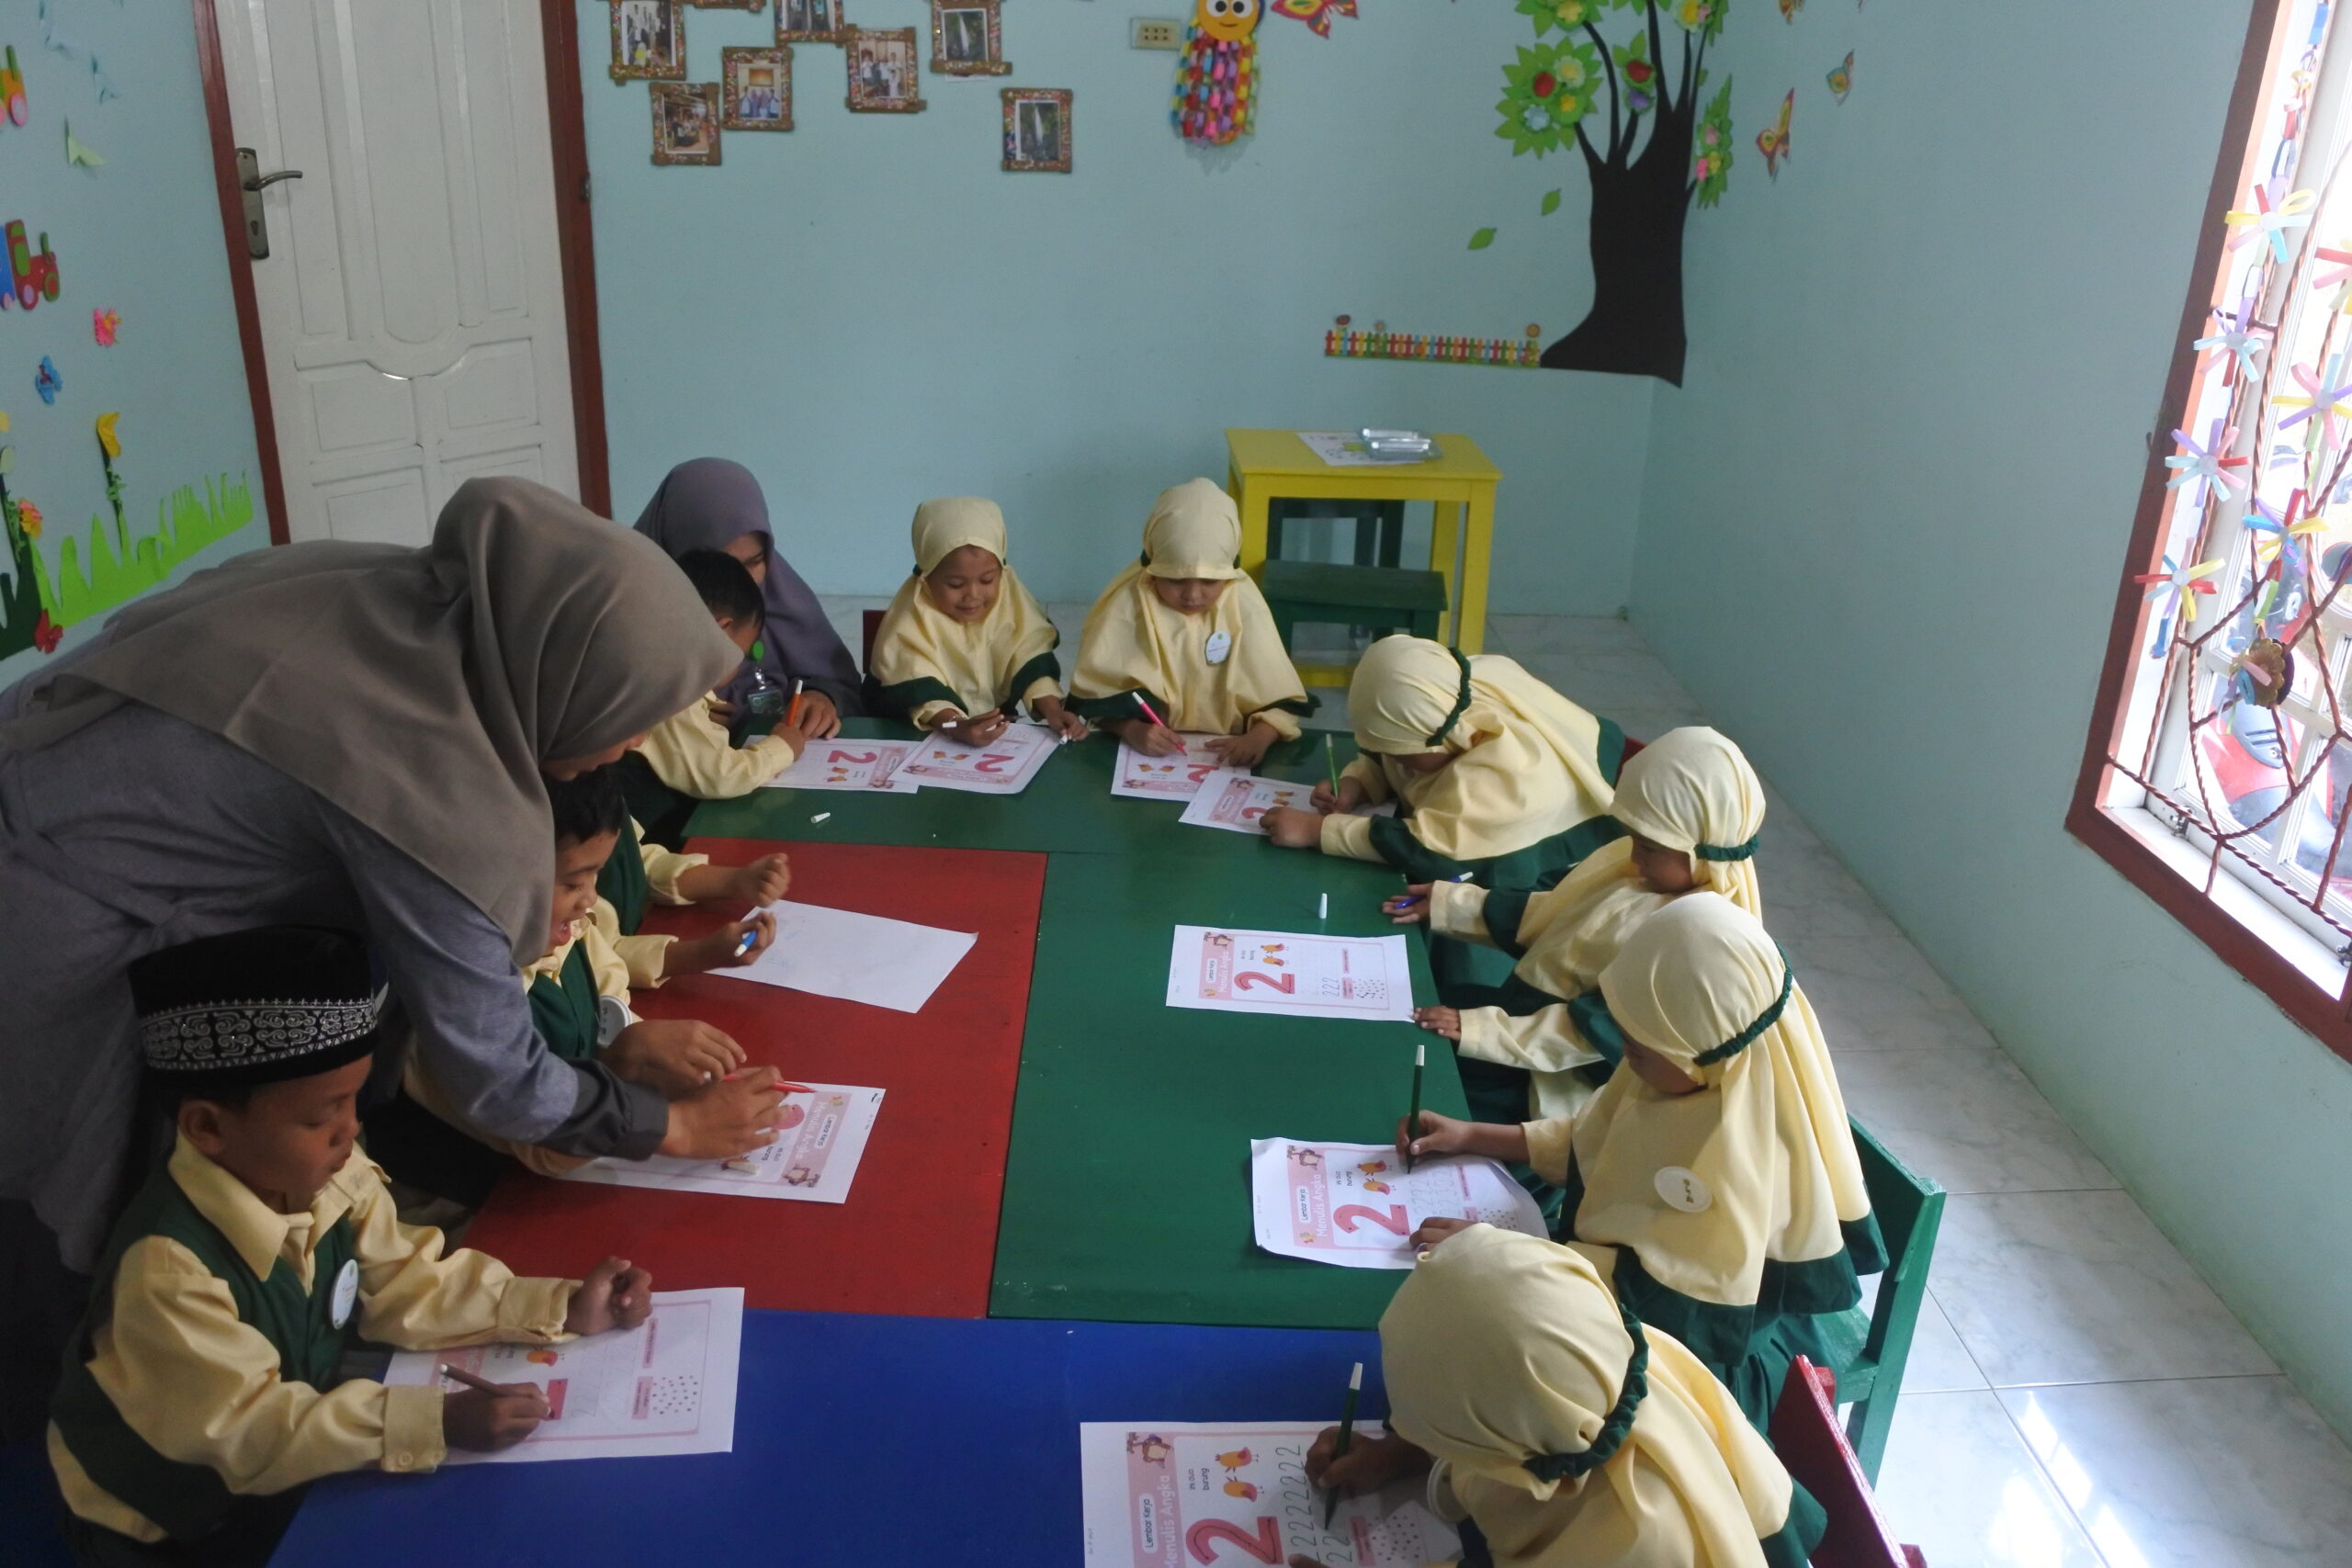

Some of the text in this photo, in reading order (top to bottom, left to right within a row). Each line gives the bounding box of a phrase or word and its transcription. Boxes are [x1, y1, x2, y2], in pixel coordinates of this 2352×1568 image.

[827, 750, 877, 764] 2
[974, 753, 1014, 773] 2
[1234, 971, 1295, 995] 2
[1311, 1174, 1328, 1236] Menulis Angka
[1333, 1203, 1410, 1236] 2
[1157, 1475, 1175, 1516] Angka
[1142, 1499, 1154, 1548] Lembar Kerja
[1185, 1516, 1283, 1566] 2
